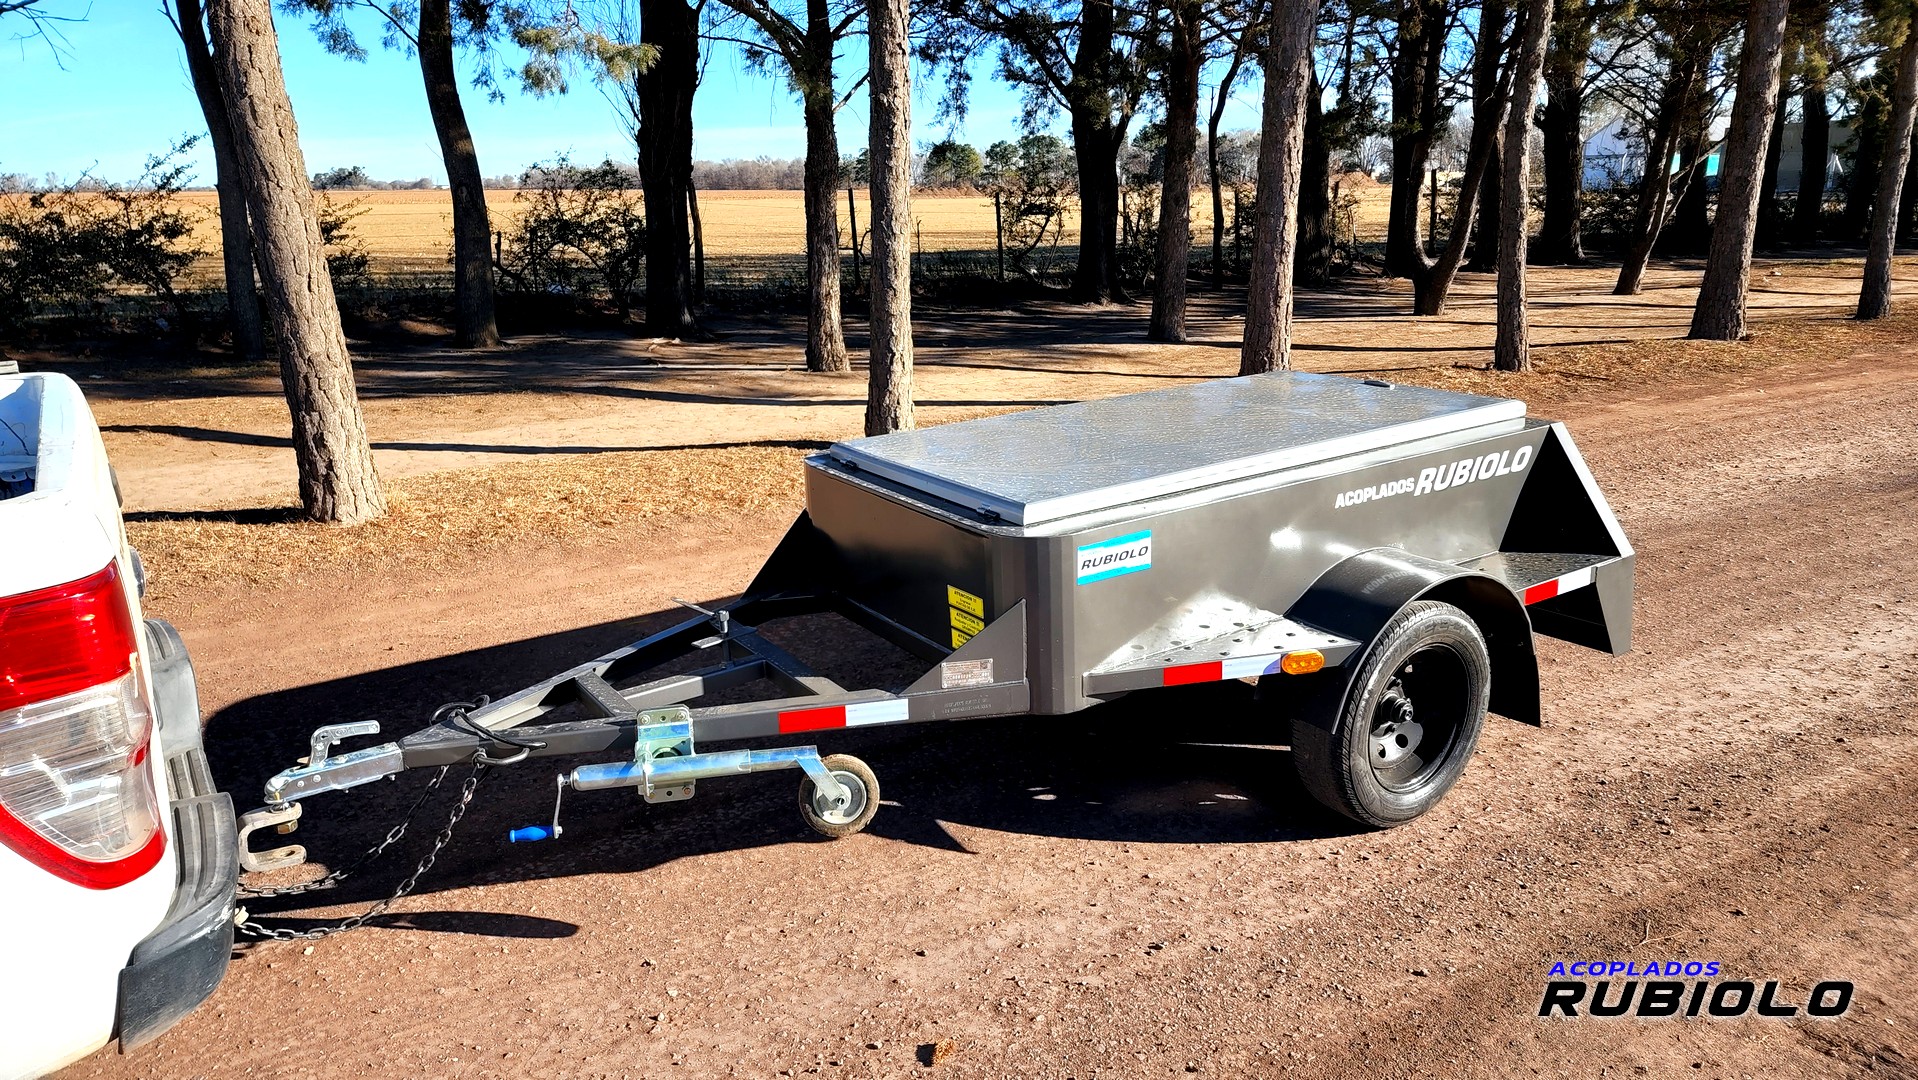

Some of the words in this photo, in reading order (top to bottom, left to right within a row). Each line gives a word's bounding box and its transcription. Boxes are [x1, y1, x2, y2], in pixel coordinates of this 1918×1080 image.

[1334, 477, 1415, 509] ACOPLADOS
[1413, 445, 1533, 497] RUBIOLO
[1081, 546, 1149, 571] RUBIOLO
